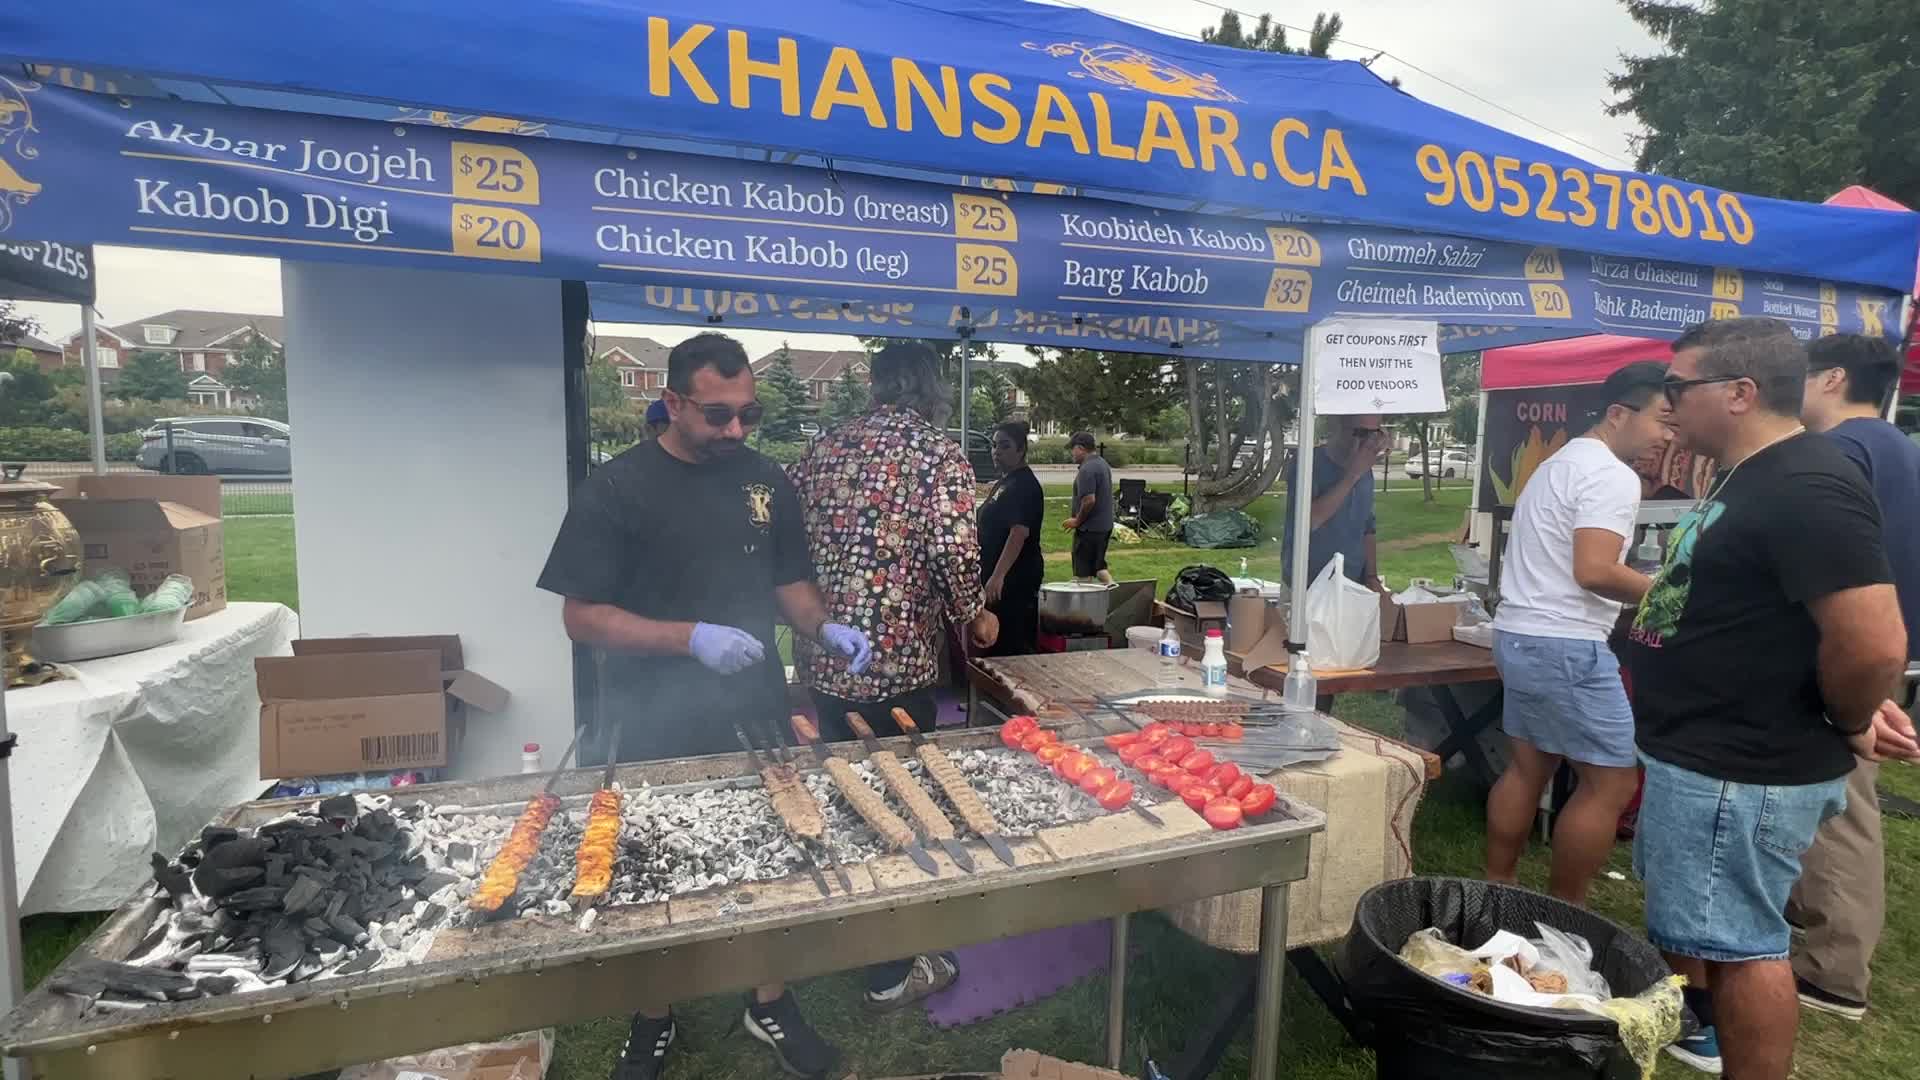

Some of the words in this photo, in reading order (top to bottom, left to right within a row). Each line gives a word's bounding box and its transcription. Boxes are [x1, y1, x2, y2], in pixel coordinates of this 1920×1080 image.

[646, 16, 1367, 197] KHANSALAR.CA
[125, 119, 287, 162] Akbar
[295, 139, 436, 183] Joojeh
[459, 153, 526, 193] $25
[594, 167, 731, 207] Chicken
[742, 180, 844, 217] Kabob
[854, 194, 949, 229] (breast)
[960, 201, 1008, 232] $25
[1415, 143, 1755, 246] 9052378010
[134, 178, 289, 226] Kabob
[301, 193, 394, 243] Digi
[459, 213, 527, 250] $20
[1060, 213, 1184, 246] Koobideh
[1187, 227, 1266, 253] Kabob
[1273, 233, 1312, 258] $20
[1347, 237, 1437, 266] Ghormeh
[1438, 245, 1486, 268] Sabzi
[595, 224, 736, 261] Chicken
[745, 235, 848, 270] Kabob
[856, 247, 909, 279] (leg)
[961, 255, 1008, 286] $25
[1063, 259, 1125, 295] Barg
[1131, 264, 1209, 294] Kabob
[1271, 277, 1307, 304] $35
[1634, 262, 1699, 288] Ghasemi
[1336, 279, 1417, 303] Gheimeh
[1423, 284, 1526, 311] Bademjoon
[1630, 298, 1705, 328] Bademjan
[1326, 334, 1344, 345] GET
[1346, 334, 1396, 346] COUPONS
[1398, 334, 1428, 347] FIRST
[1339, 357, 1367, 368] THEN
[1369, 357, 1393, 369] VISIT
[1393, 358, 1413, 369] THE
[1336, 379, 1365, 390] FOOD
[1367, 379, 1418, 390] VENDORS
[1516, 401, 1568, 422] CORN
